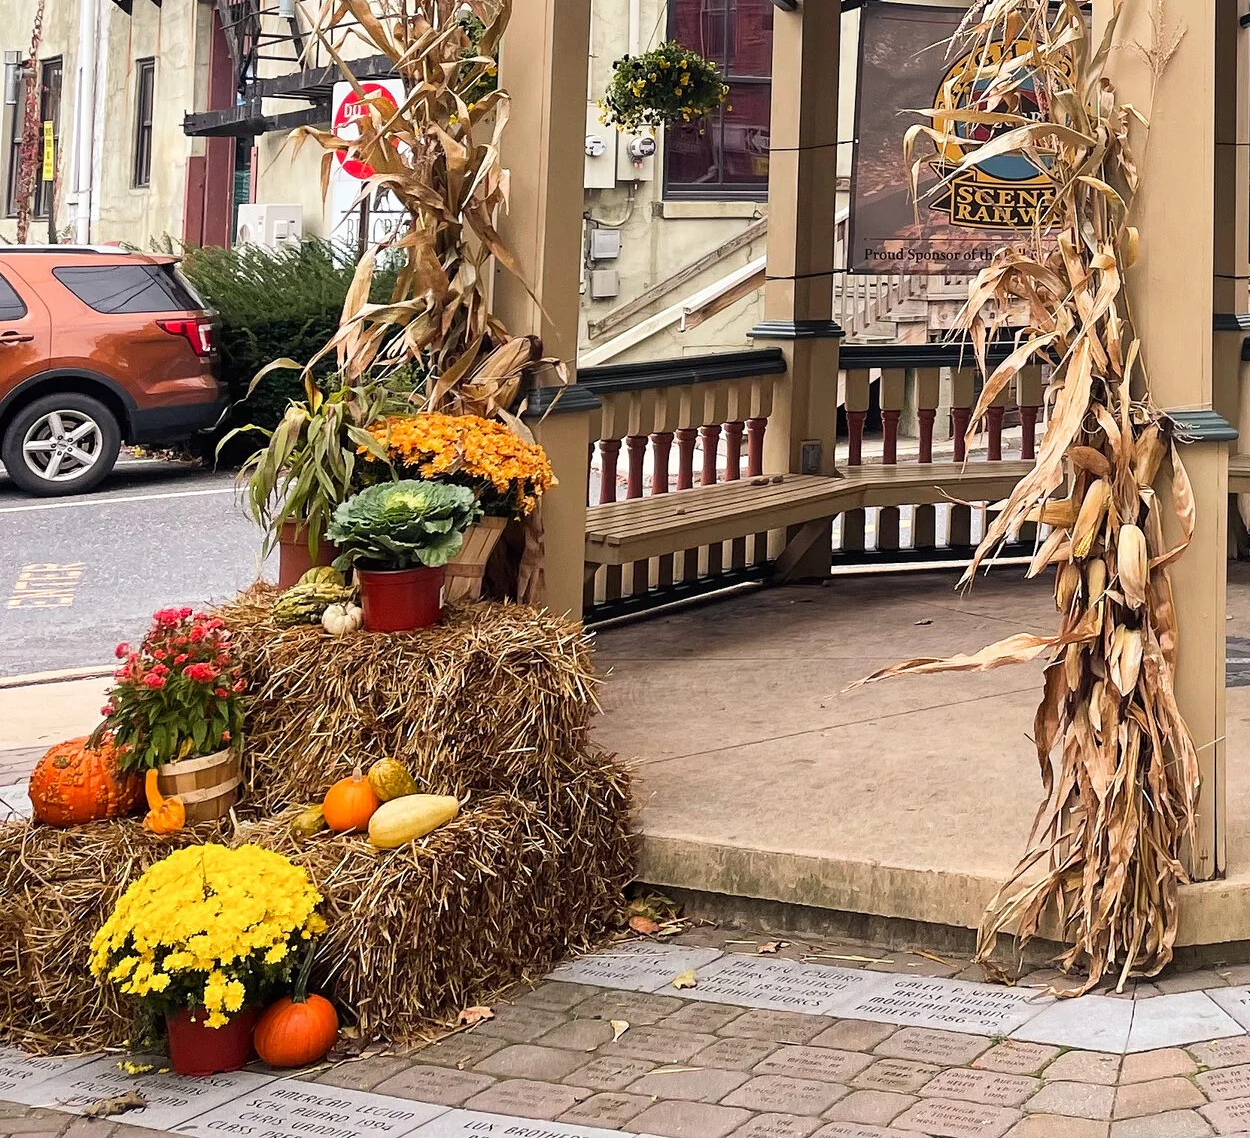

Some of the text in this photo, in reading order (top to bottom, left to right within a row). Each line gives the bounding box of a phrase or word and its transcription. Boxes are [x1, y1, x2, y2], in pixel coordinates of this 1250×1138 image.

[344, 104, 362, 118] DO
[957, 187, 1055, 206] SCENI
[955, 204, 1060, 223] RAILW
[864, 248, 904, 261] Proud
[908, 248, 960, 263] Sponsor
[963, 248, 977, 261] of
[980, 248, 993, 261] th
[869, 995, 1012, 1021] MOUNTAIN BIKING
[247, 1099, 290, 1114] SCHL
[291, 1107, 351, 1128] AWARD
[270, 1089, 416, 1121] AMERICAN LEGION
[206, 1120, 258, 1137] CLASS
[238, 1112, 286, 1127] CHRIS
[503, 1126, 592, 1138] BROTHE
